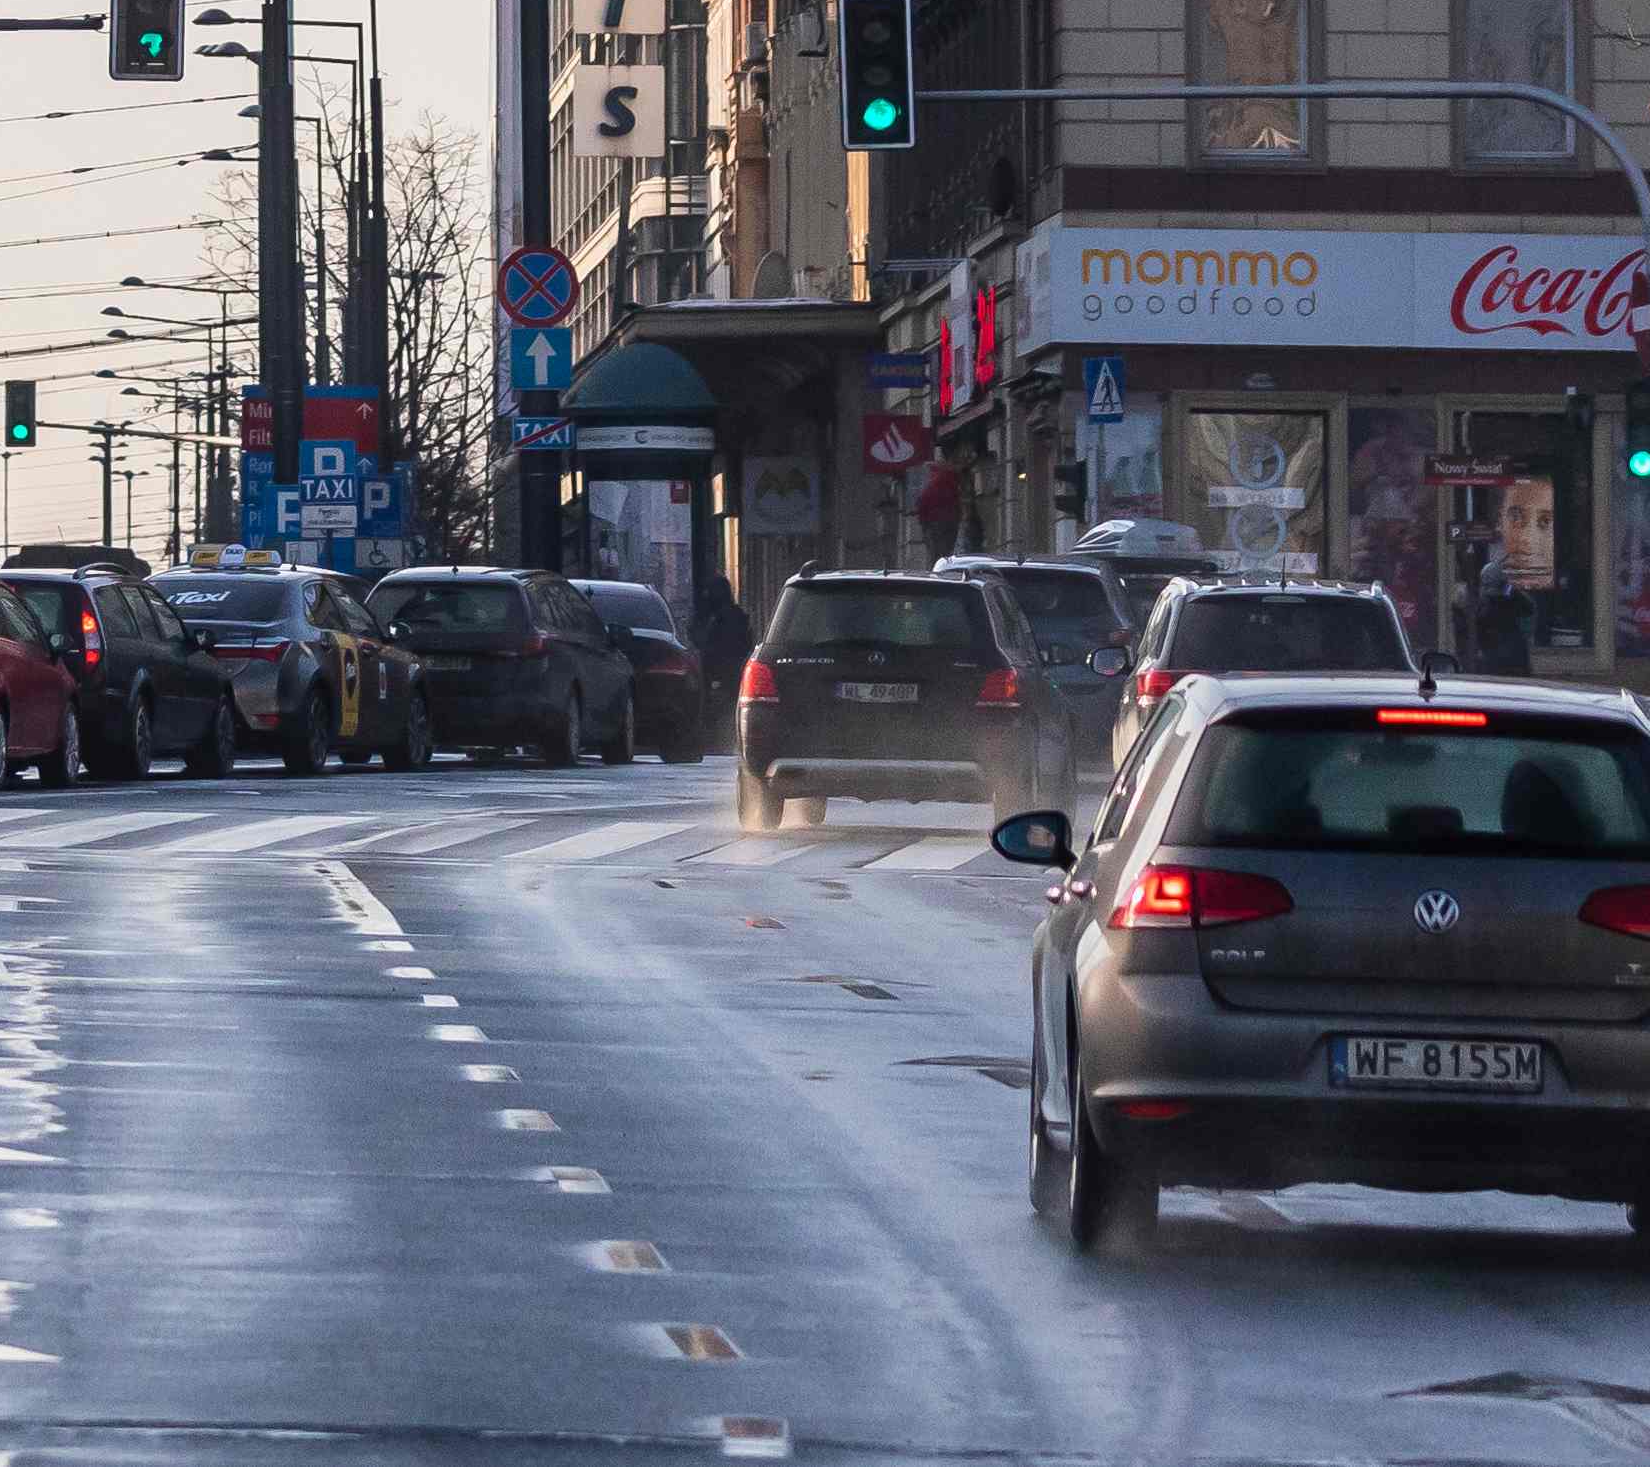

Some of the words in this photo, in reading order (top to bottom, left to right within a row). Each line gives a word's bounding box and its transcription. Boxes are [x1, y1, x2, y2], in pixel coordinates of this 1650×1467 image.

[1082, 248, 1319, 287] mommo
[302, 479, 354, 500] TAXI
[1354, 1040, 1407, 1077] WF
[1421, 1044, 1538, 1082] 8155M
